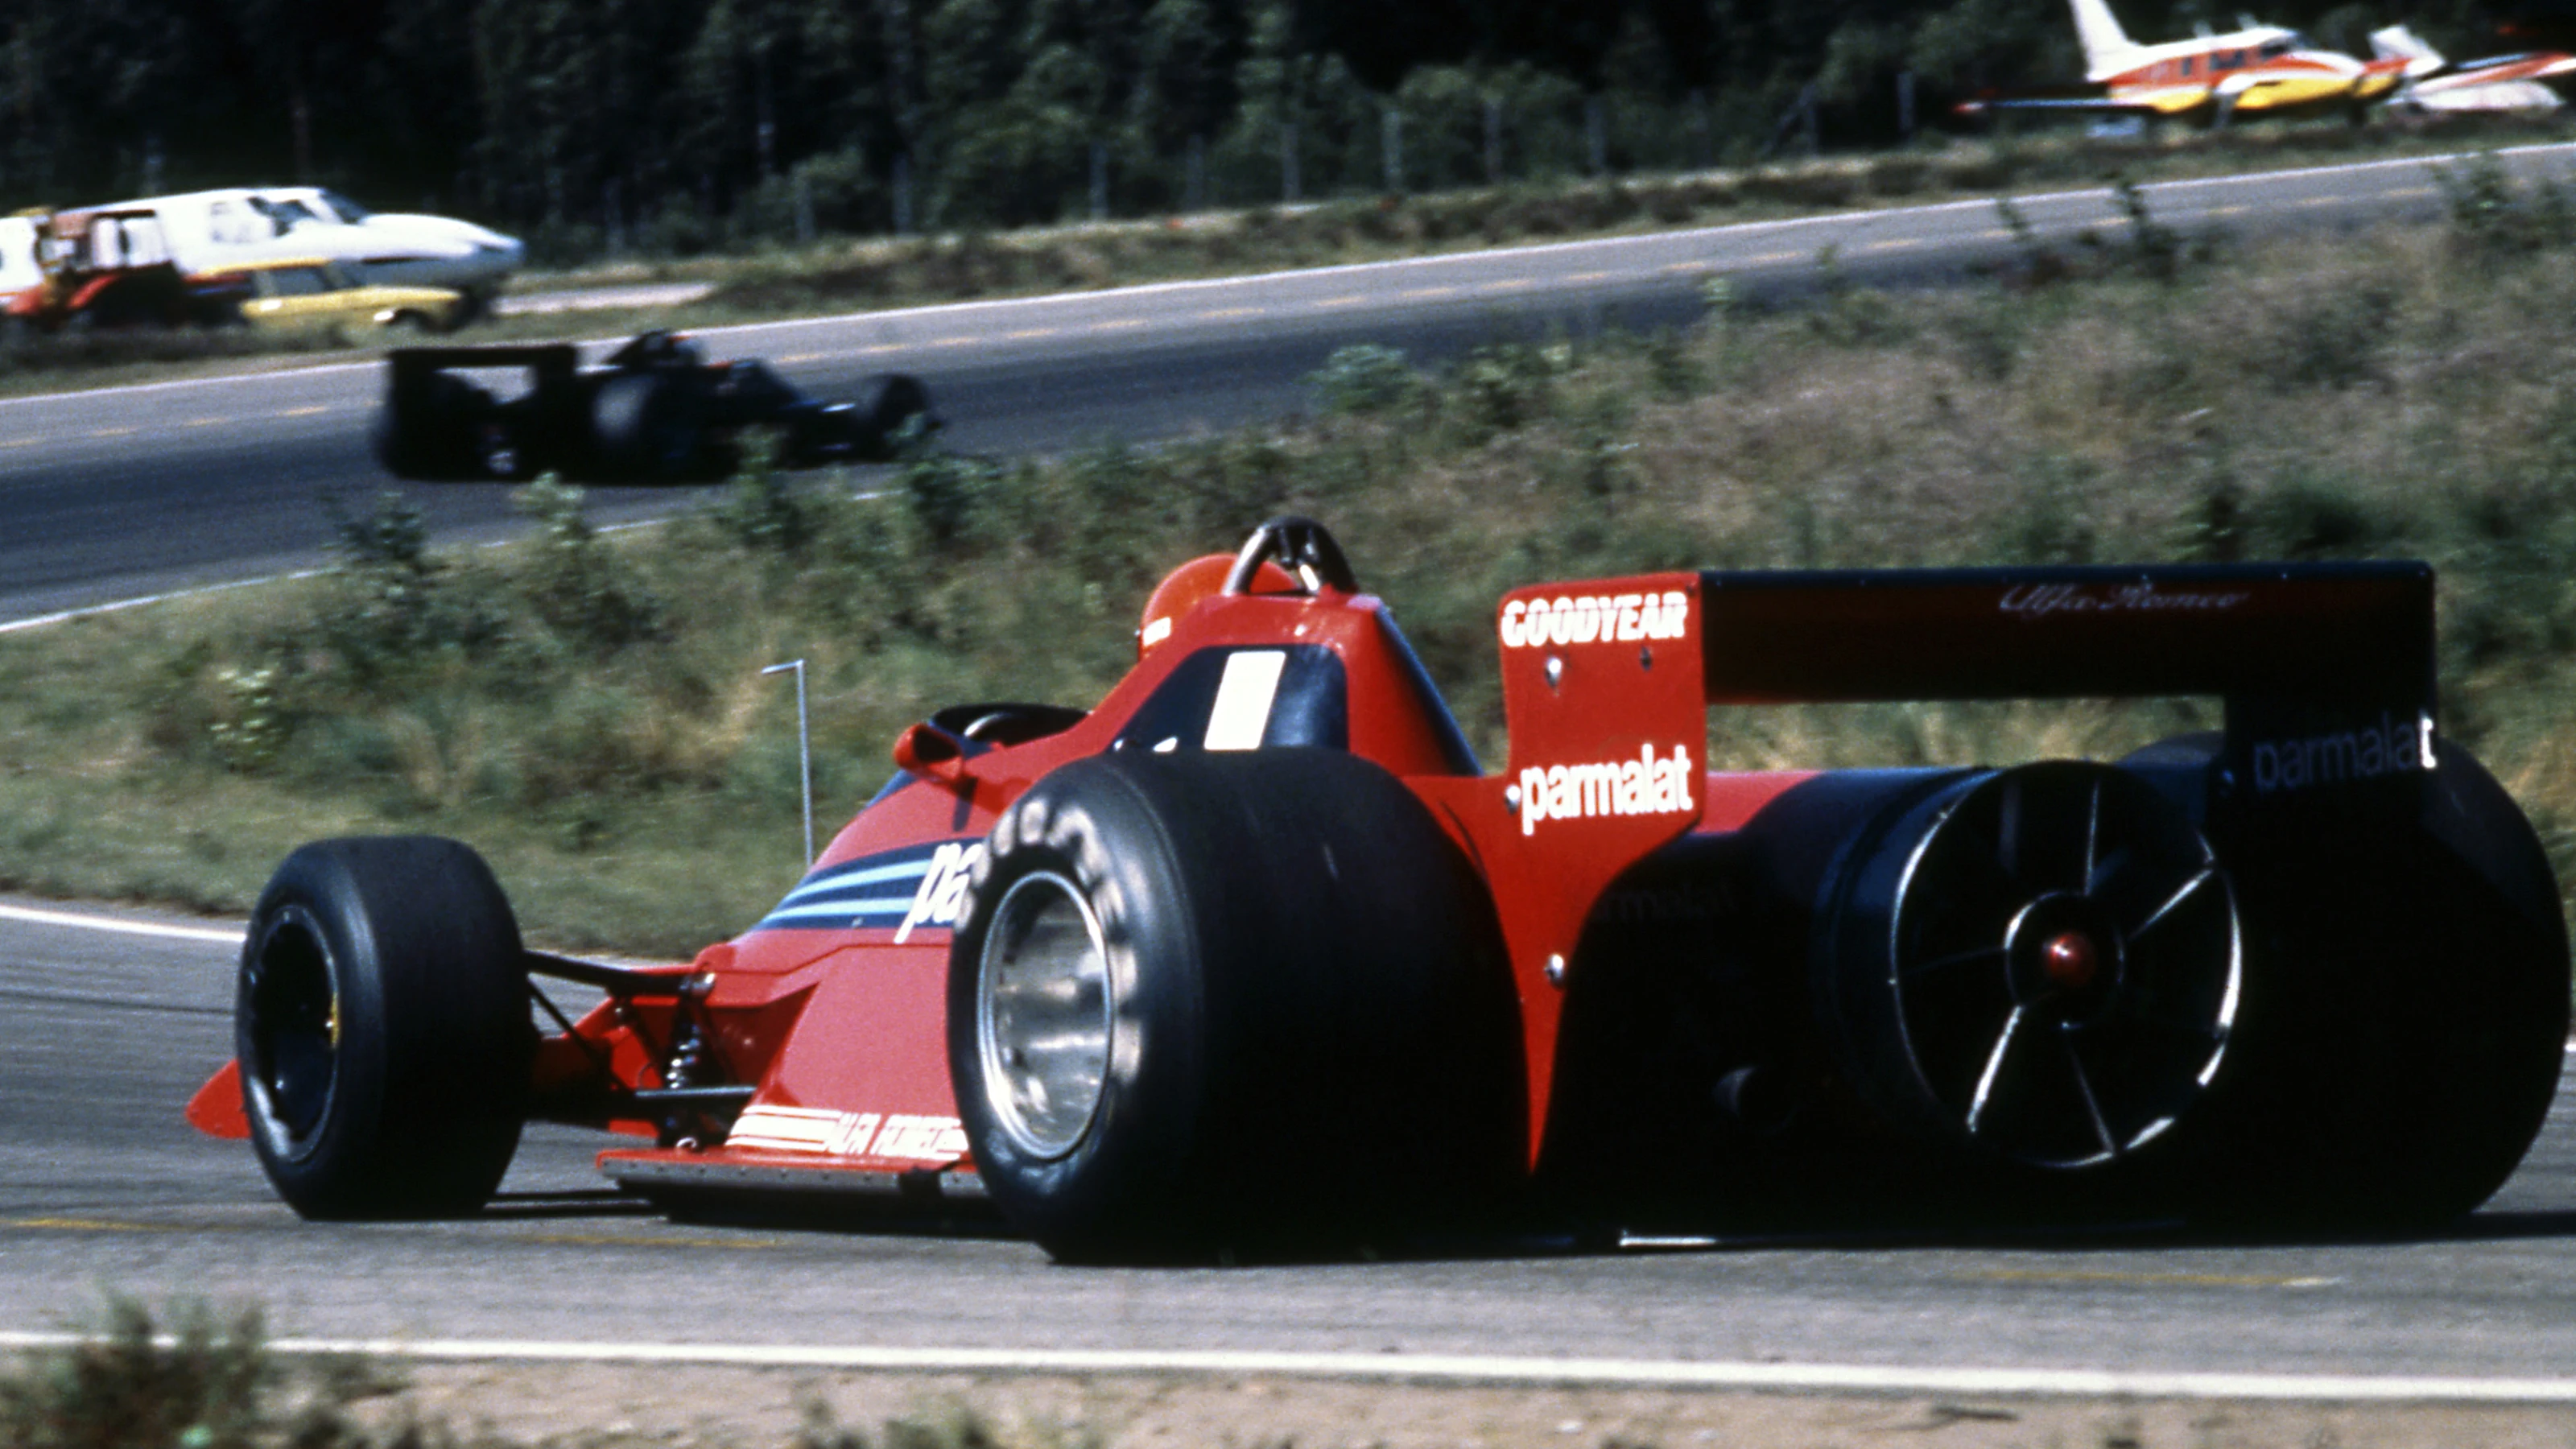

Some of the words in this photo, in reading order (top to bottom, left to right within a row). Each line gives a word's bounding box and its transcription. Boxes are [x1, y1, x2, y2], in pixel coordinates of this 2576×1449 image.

[1501, 592, 1687, 647] GOODYEAR
[1203, 650, 1286, 750] 1
[1520, 742, 1694, 836] parmalat
[2253, 708, 2439, 795] parmalat
